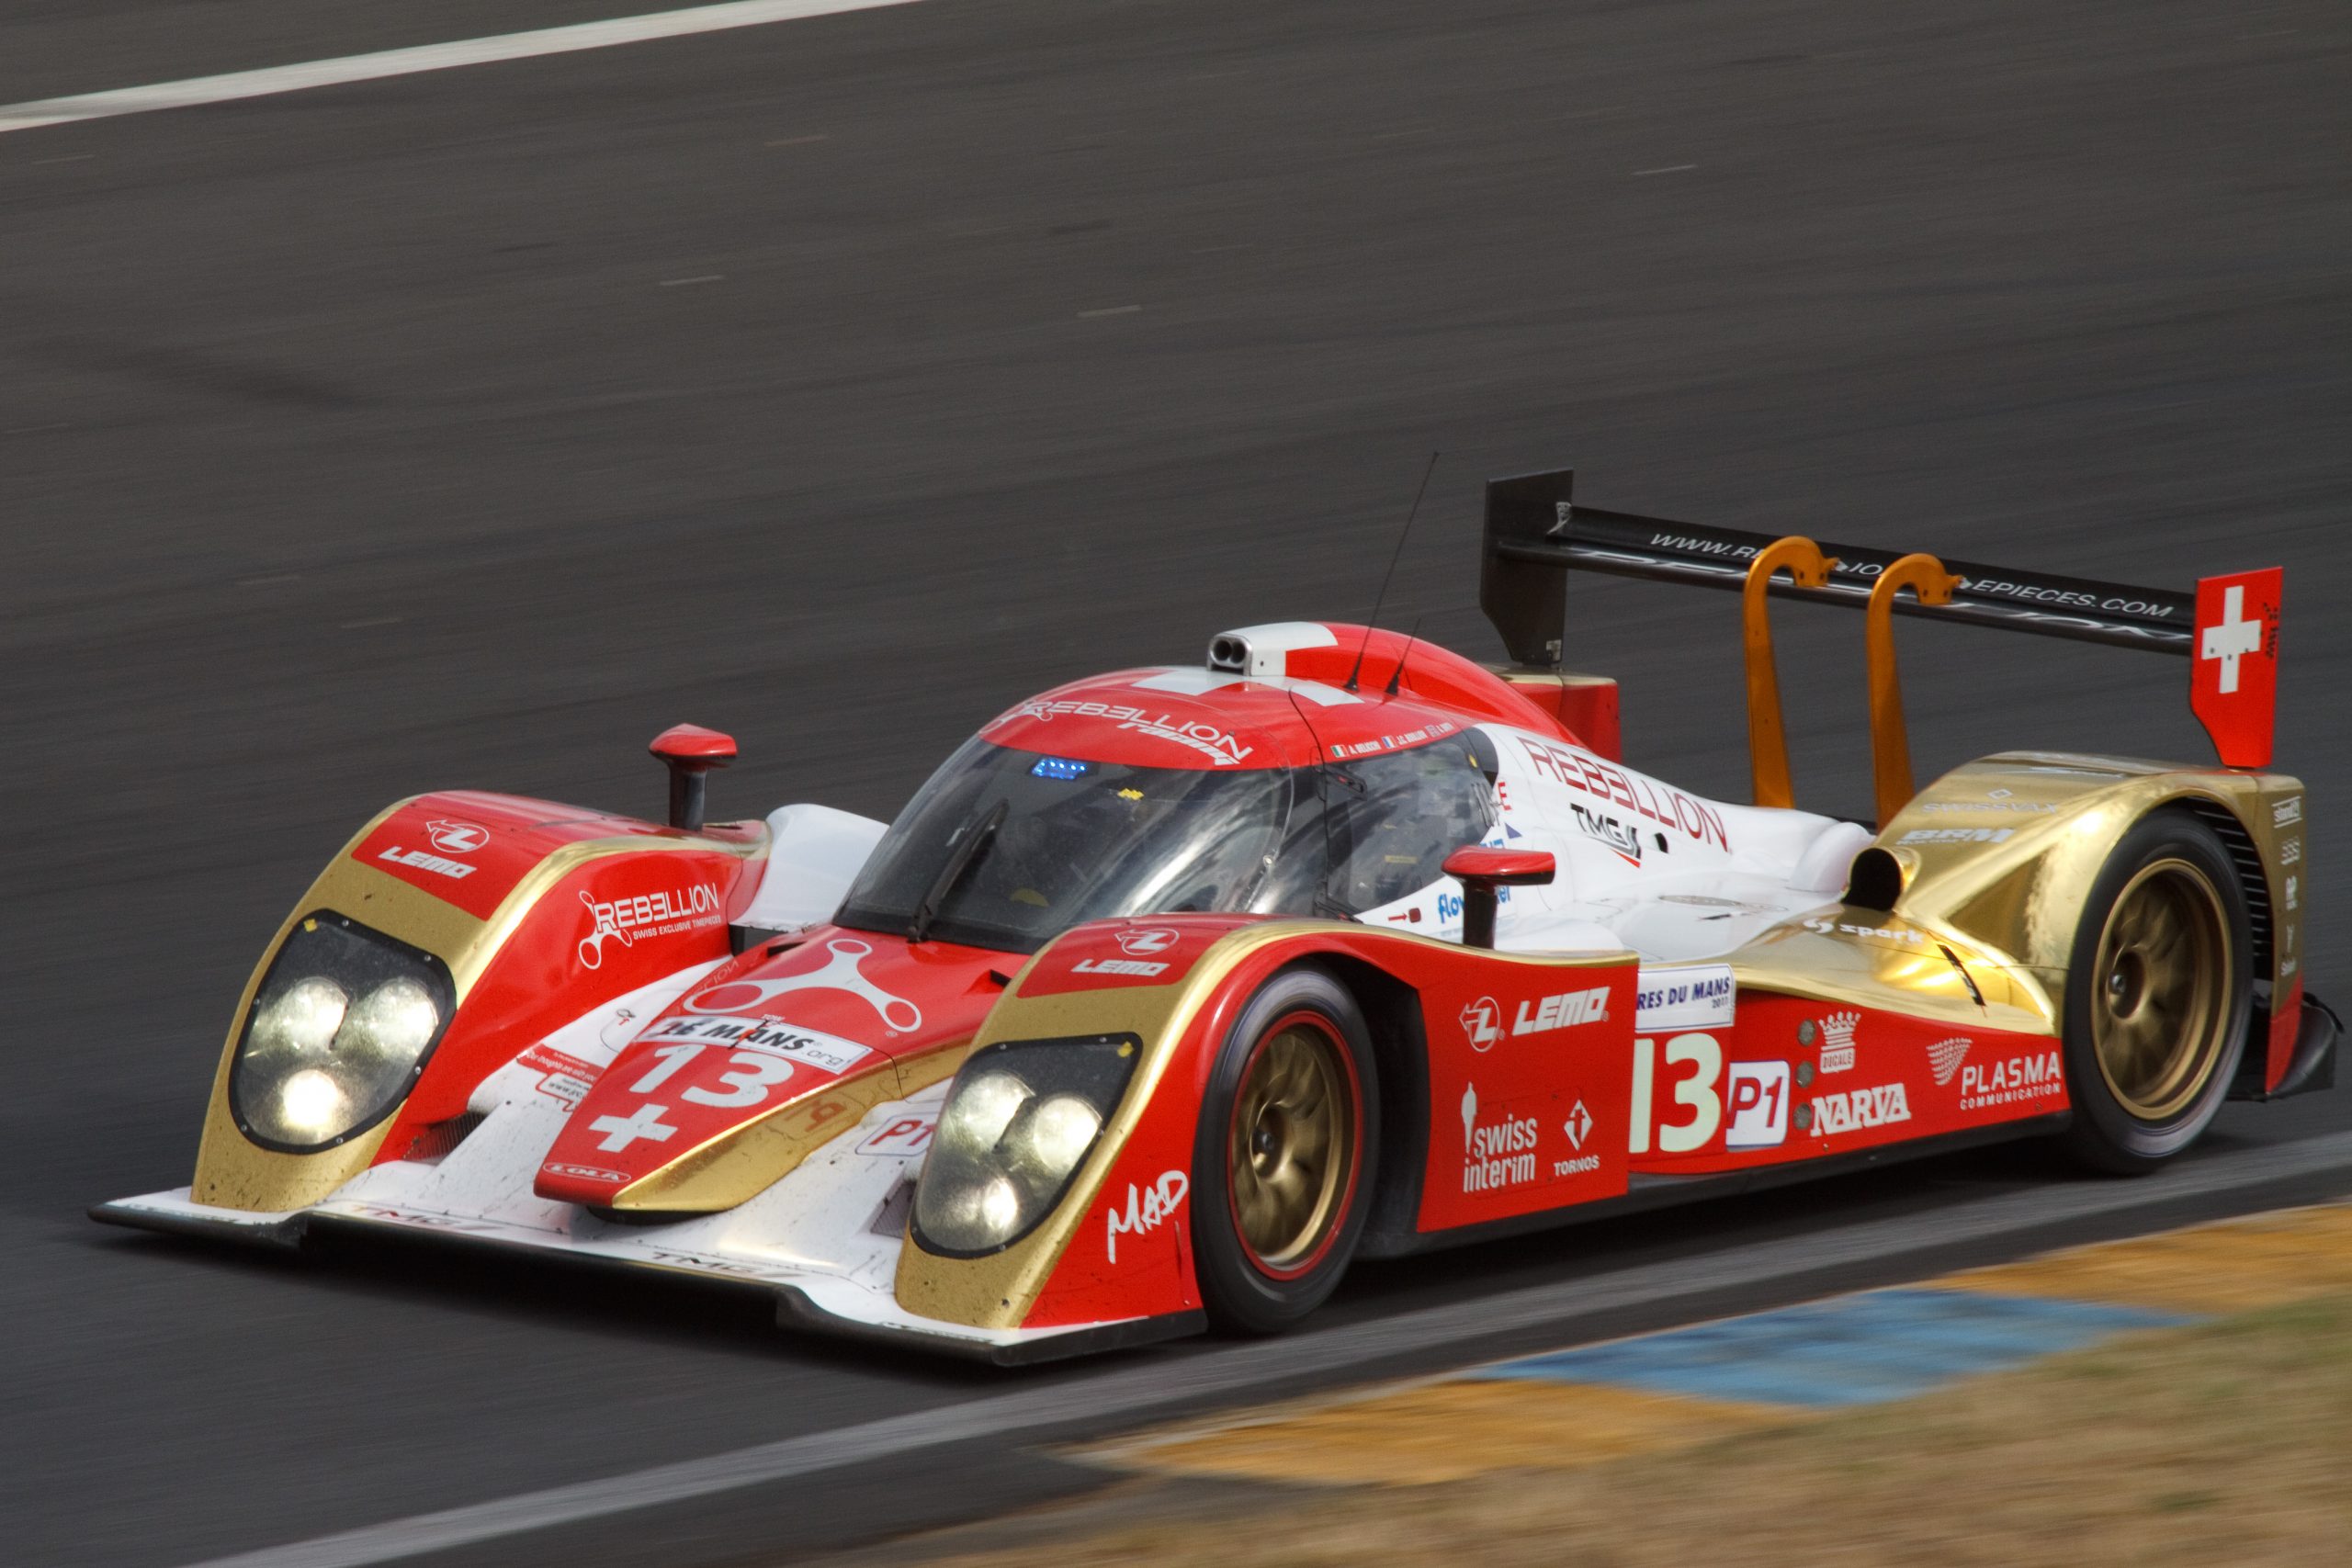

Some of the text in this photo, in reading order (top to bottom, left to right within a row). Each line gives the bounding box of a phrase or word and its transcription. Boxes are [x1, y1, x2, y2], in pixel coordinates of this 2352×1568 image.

[1516, 736, 1728, 852] REBELLION
[378, 845, 477, 879] LEMO
[594, 882, 720, 932] REBELLION
[633, 927, 658, 941] SWISS
[659, 919, 692, 936] EXCLUSIVE
[1070, 958, 1171, 976] LEMO
[1511, 986, 1611, 1037] LEMO
[1668, 985, 1689, 1006] DU
[1691, 976, 1731, 1001] MANS
[701, 1024, 814, 1052] MANS
[627, 1043, 795, 1109] 13
[1628, 1032, 1723, 1154] 13
[1961, 1051, 2063, 1096] PLASMA
[1726, 1077, 1783, 1131] P1
[1810, 1082, 1912, 1138] NARVA
[1960, 1082, 2062, 1112] COMMUNICATION
[868, 1119, 936, 1147] P1
[1474, 1112, 1538, 1159] swiss
[1463, 1152, 1536, 1193] interim
[1553, 1155, 1600, 1177] TORNOS
[1107, 1169, 1189, 1265] MAD
